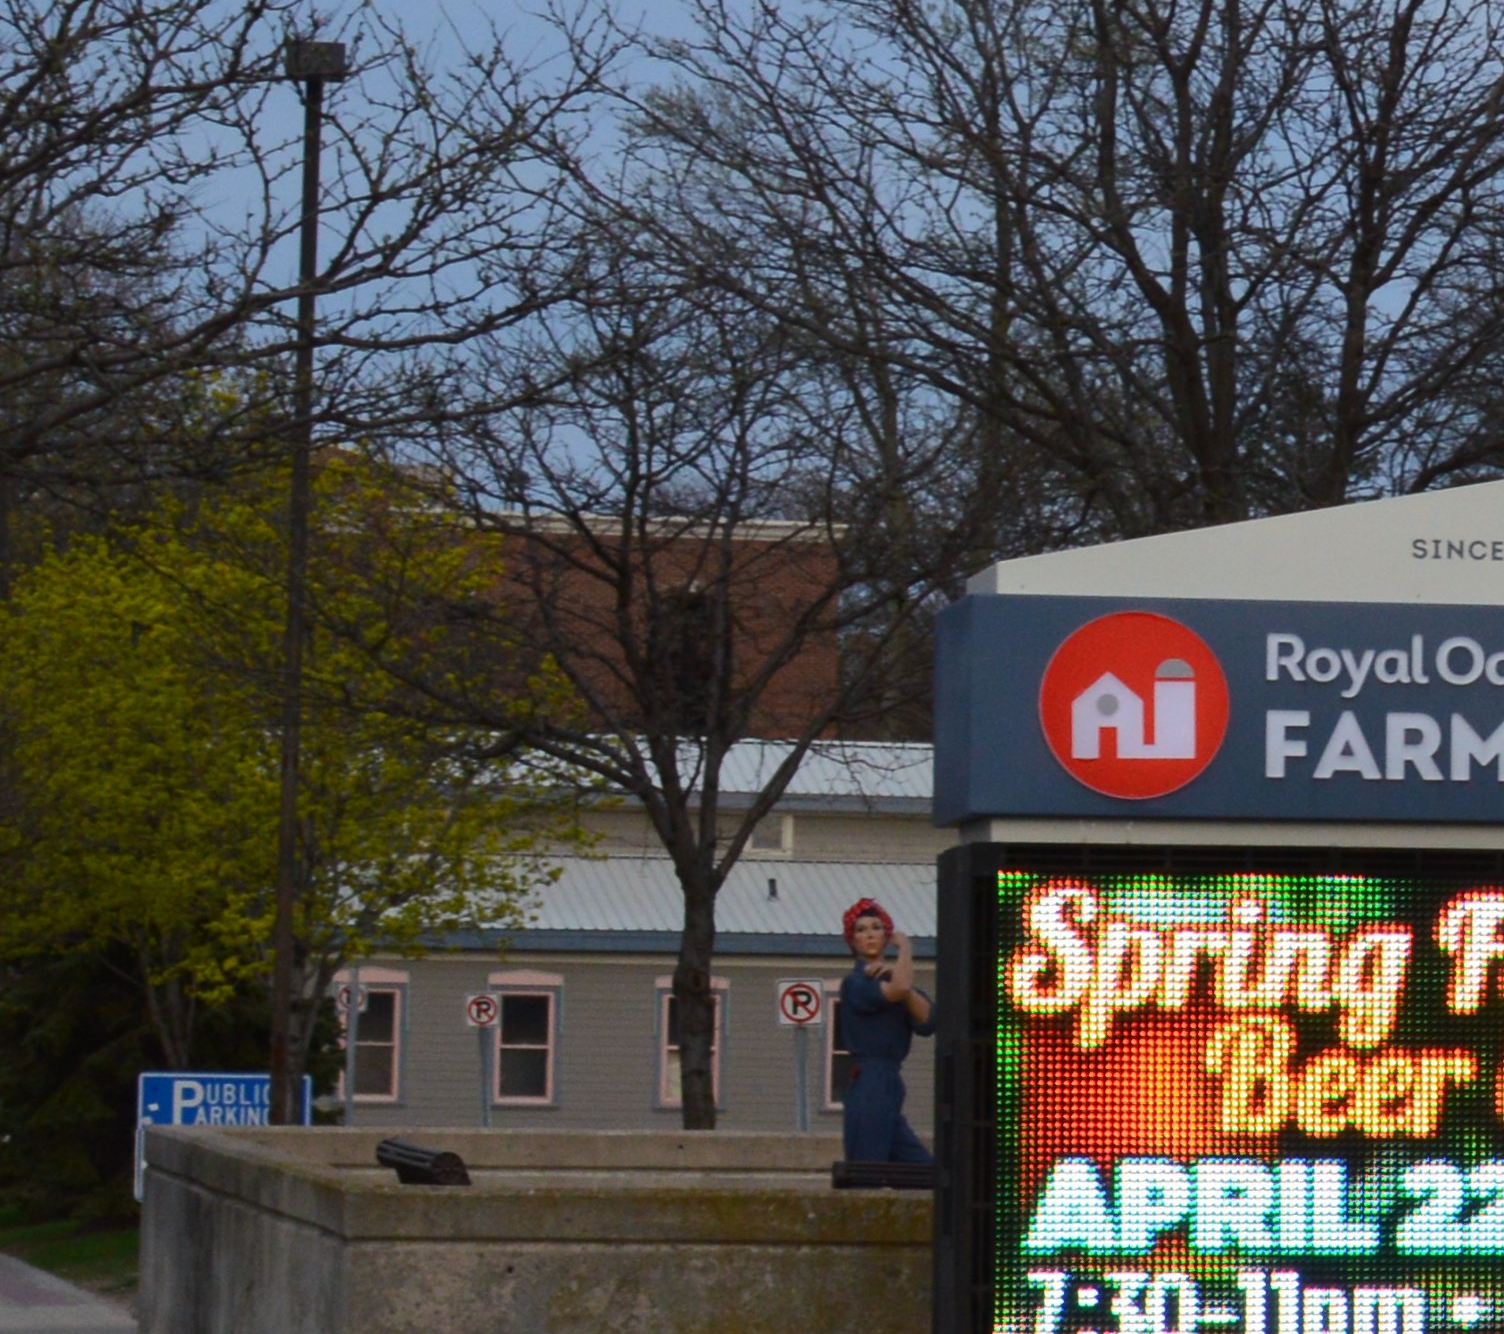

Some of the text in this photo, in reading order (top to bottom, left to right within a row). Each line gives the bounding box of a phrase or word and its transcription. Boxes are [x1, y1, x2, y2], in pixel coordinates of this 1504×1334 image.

[1411, 538, 1504, 562] SINCE
[1266, 632, 1427, 698] Royal
[1005, 879, 1414, 1049] Spring
[1205, 1013, 1476, 1139] Beer
[1020, 1155, 1380, 1255] APRIL
